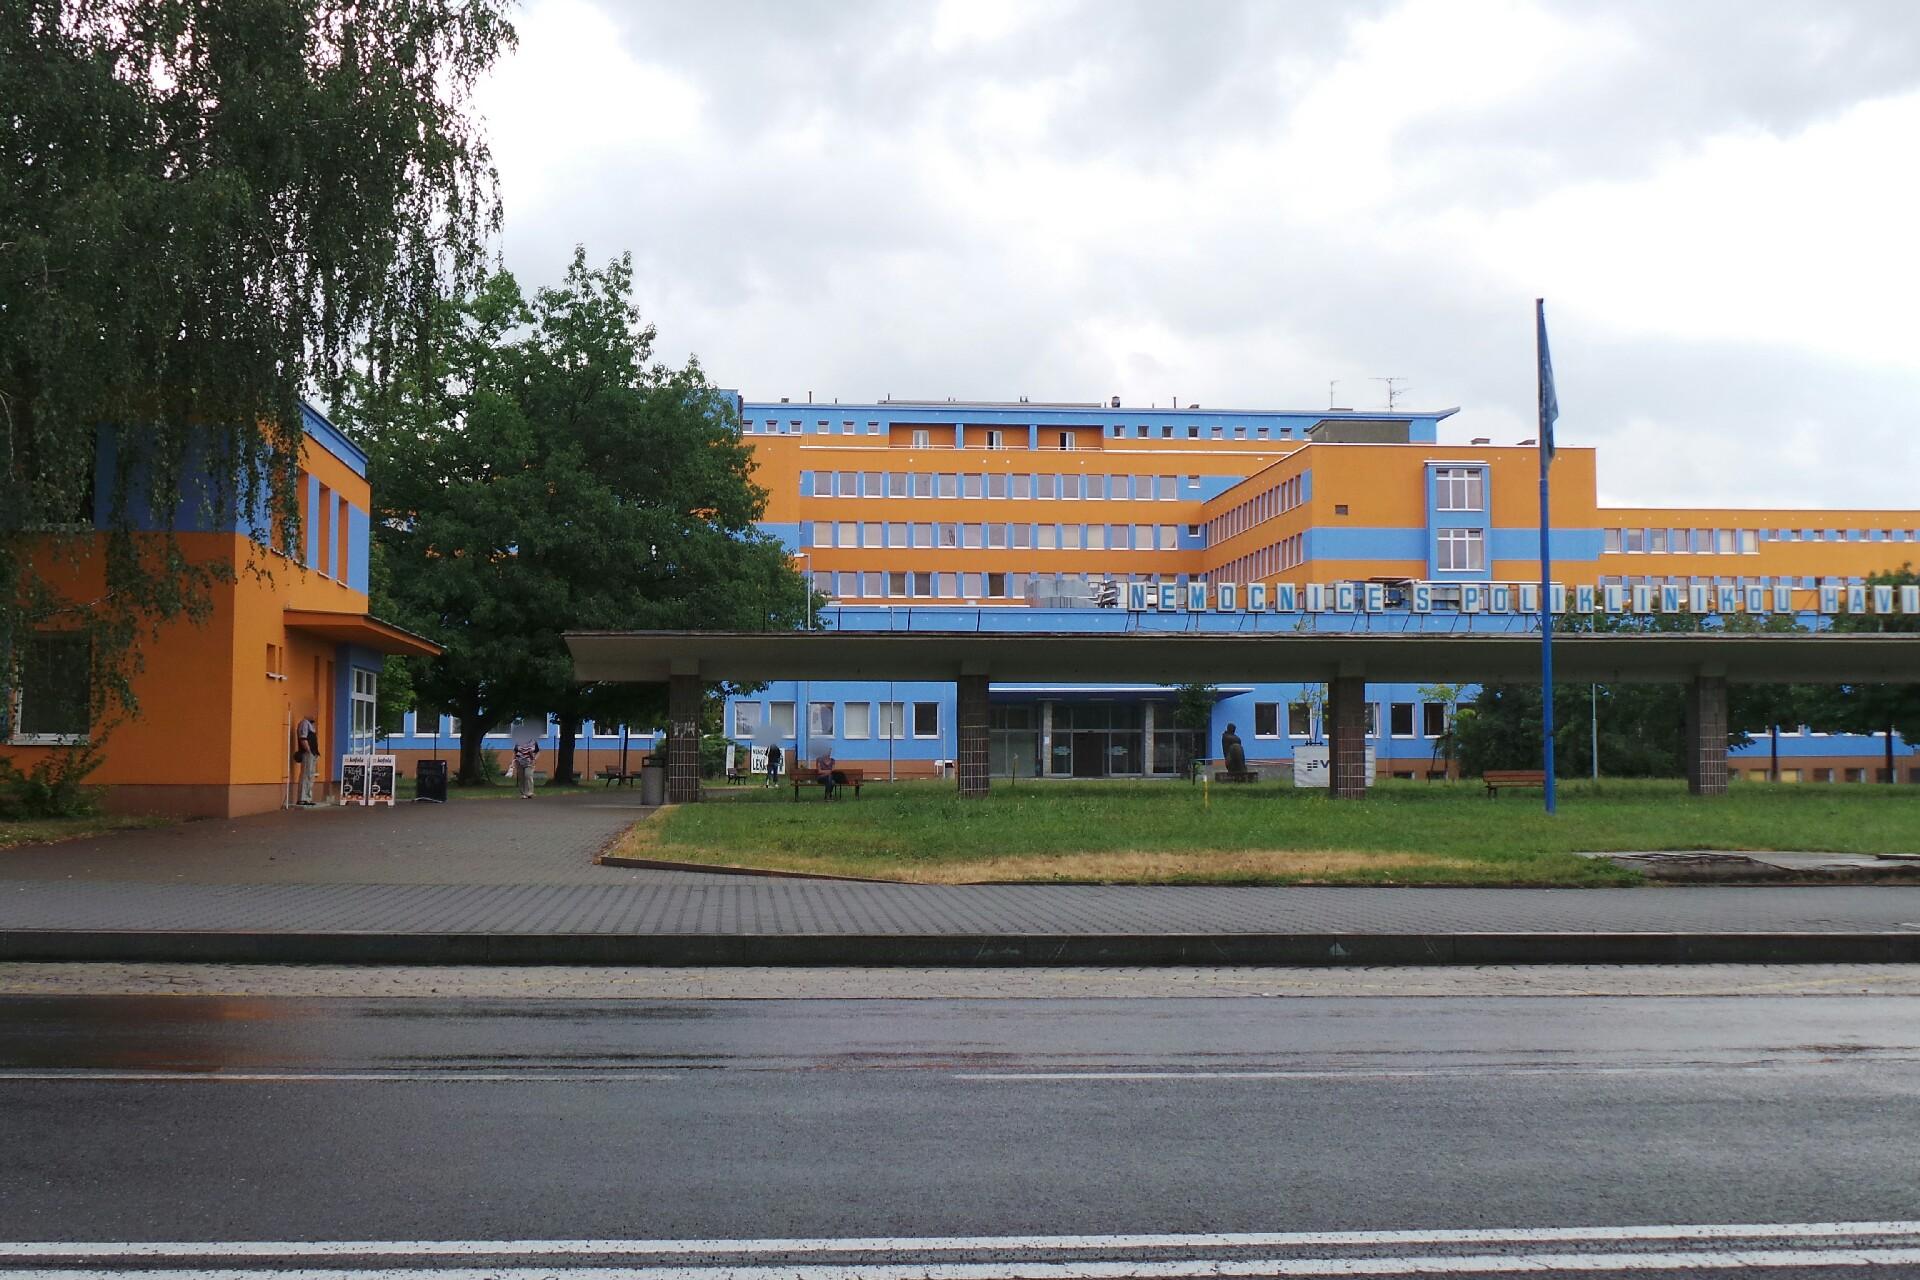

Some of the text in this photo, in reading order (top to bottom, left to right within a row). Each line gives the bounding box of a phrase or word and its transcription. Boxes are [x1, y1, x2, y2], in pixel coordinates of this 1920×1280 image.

[1131, 585, 1381, 611] NEMOCNICE
[1416, 587, 1429, 611] S
[1464, 587, 1790, 612] POLIKLINIKOU
